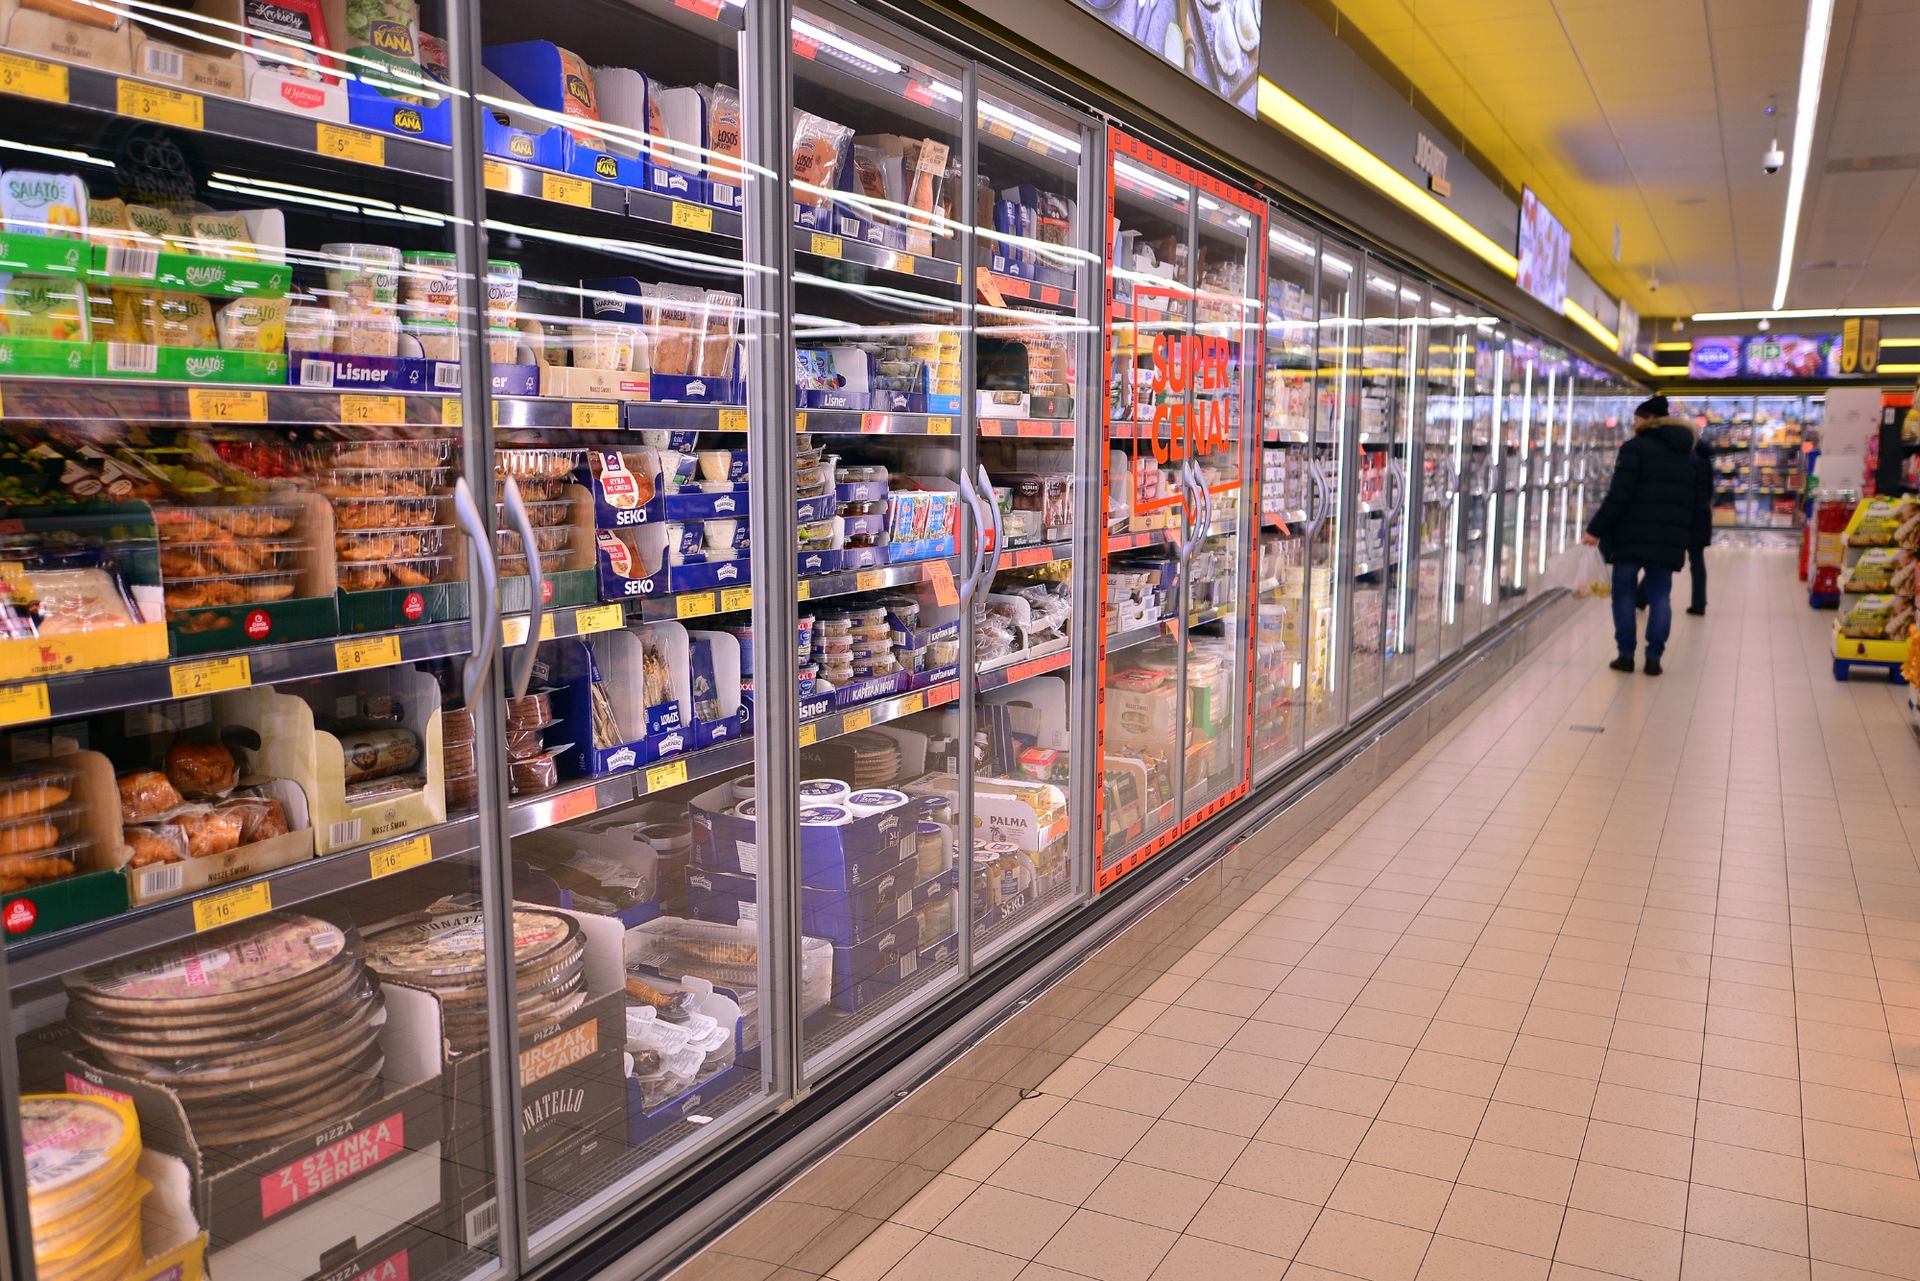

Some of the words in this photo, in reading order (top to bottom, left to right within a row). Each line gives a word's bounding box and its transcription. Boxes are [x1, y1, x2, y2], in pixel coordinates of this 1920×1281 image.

[374, 31, 413, 54] RANA
[4, 69, 12, 85] 3
[142, 99, 150, 113] 3
[395, 114, 422, 130] RANA
[339, 140, 344, 152] 5
[718, 130, 738, 146] ŁOSOŚ
[511, 141, 532, 155] RANA
[596, 163, 617, 176] RANA
[661, 310, 686, 321] MAKRELA
[1152, 332, 1230, 395] SUPER
[336, 362, 389, 382] Lisner
[824, 394, 847, 407] Lisner
[214, 402, 227, 416] 12
[357, 407, 368, 418] 12
[1151, 396, 1230, 465] CENA!
[610, 477, 625, 485] RYBA
[616, 509, 646, 525] SEKO
[624, 579, 654, 595] SEKO
[354, 651, 361, 663] 8
[194, 674, 201, 688] 2
[799, 700, 829, 718] isner
[990, 815, 1028, 828] PALMA
[385, 856, 396, 867] 16
[216, 905, 229, 918] 16
[1001, 893, 1025, 918] SEKO
[534, 1023, 562, 1042] PIZZA
[520, 1026, 586, 1070] URCZAK
[521, 1036, 597, 1087] IECZARKI
[521, 1088, 585, 1136] NATELLO
[316, 1122, 353, 1147] PIZZA
[280, 1167, 293, 1189] Z
[302, 1122, 391, 1178] SZYNKĄ
[292, 1183, 299, 1202] I
[308, 1145, 379, 1193] SEREM
